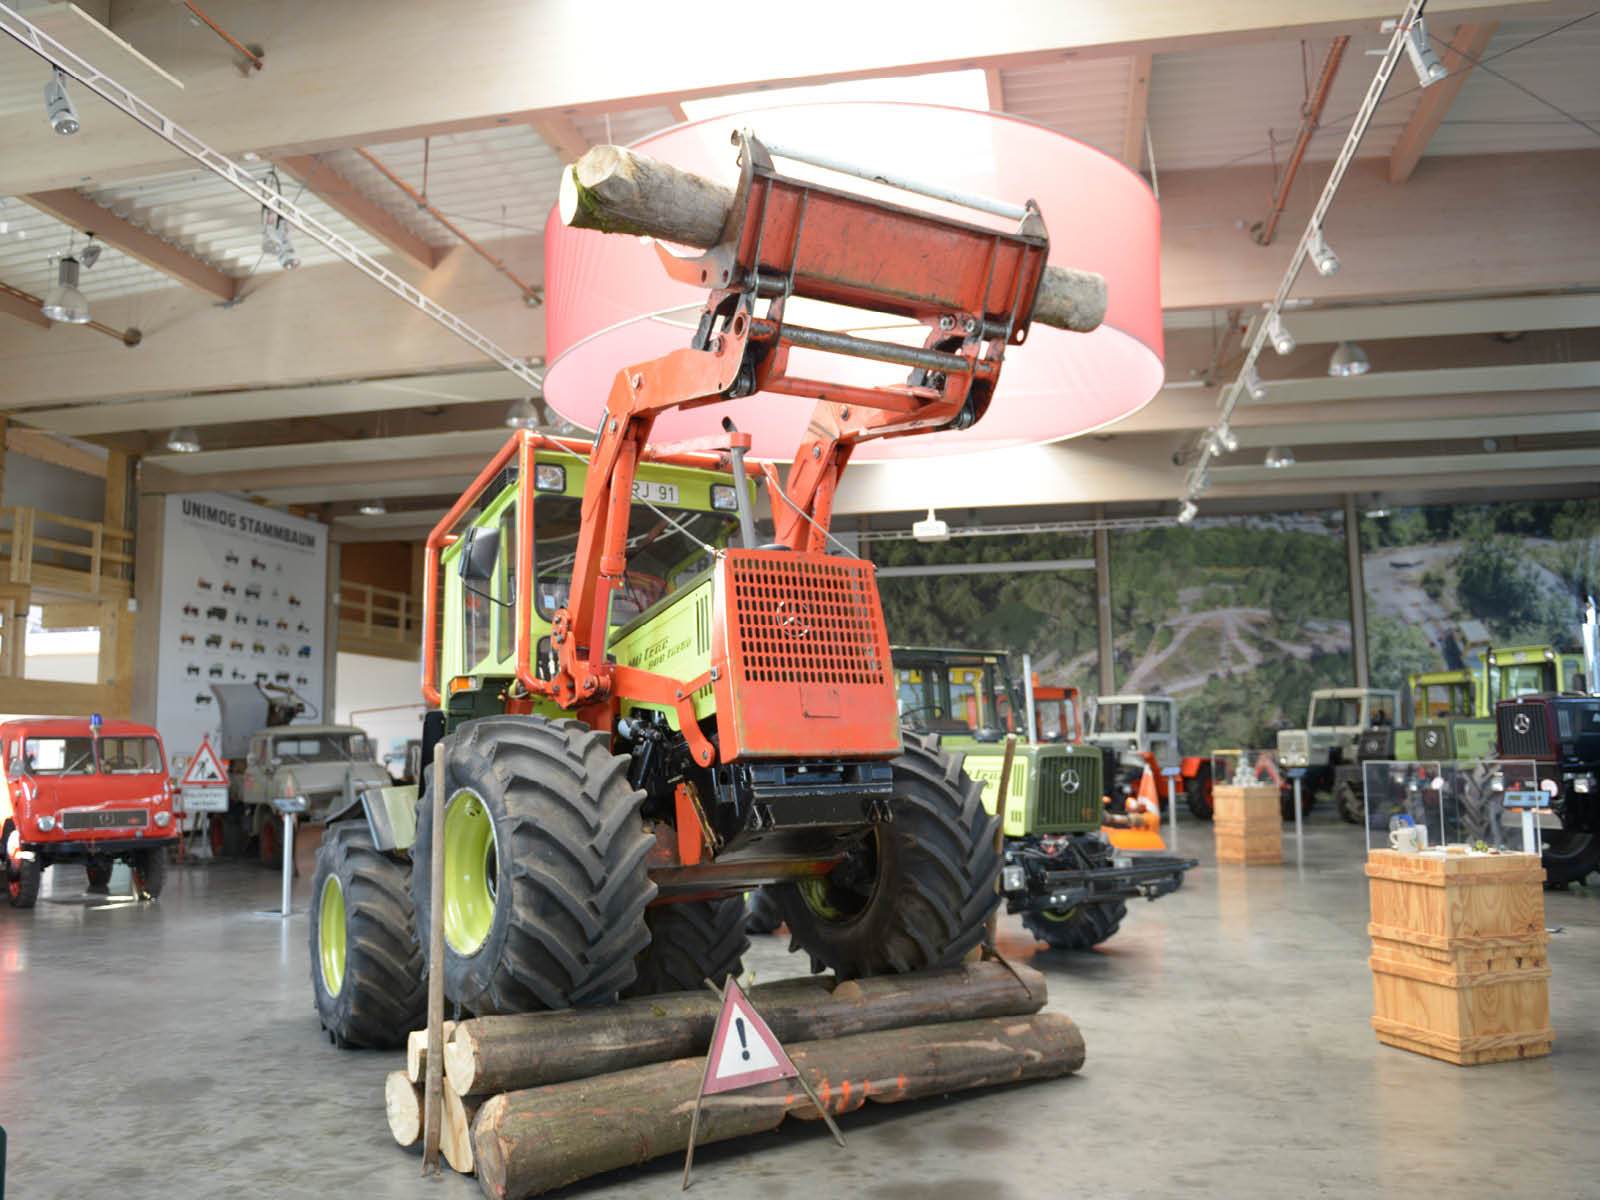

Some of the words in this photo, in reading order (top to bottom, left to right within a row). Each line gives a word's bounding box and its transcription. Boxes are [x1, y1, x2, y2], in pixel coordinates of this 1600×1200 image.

[658, 486, 673, 501] 91
[182, 499, 237, 528] UNIMOG
[239, 515, 316, 548] STAMMBAUM
